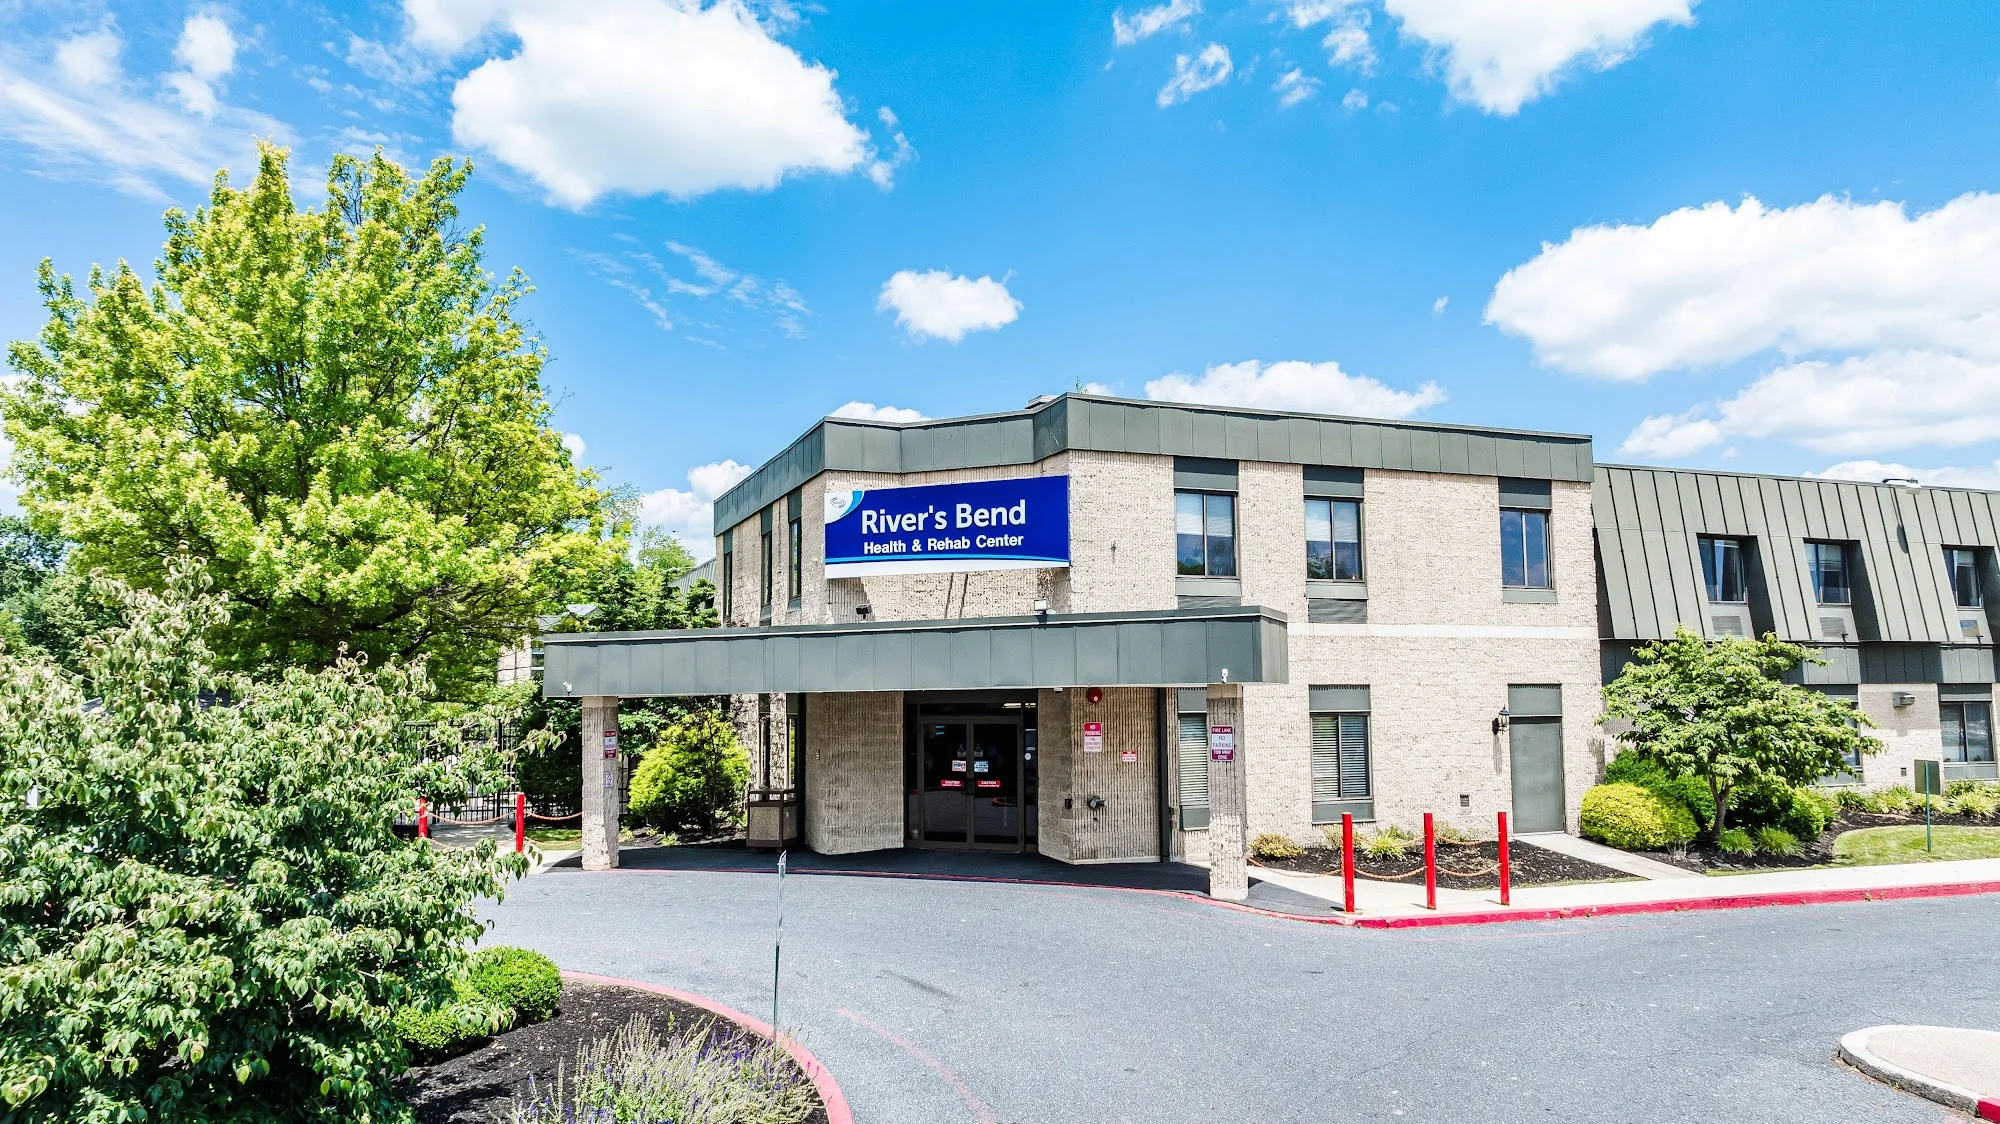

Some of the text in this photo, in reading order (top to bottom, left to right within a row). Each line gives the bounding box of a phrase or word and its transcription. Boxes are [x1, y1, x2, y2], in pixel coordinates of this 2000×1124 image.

[861, 499, 1026, 535] River's Bend
[863, 534, 1024, 555] Health & Rehab Center
